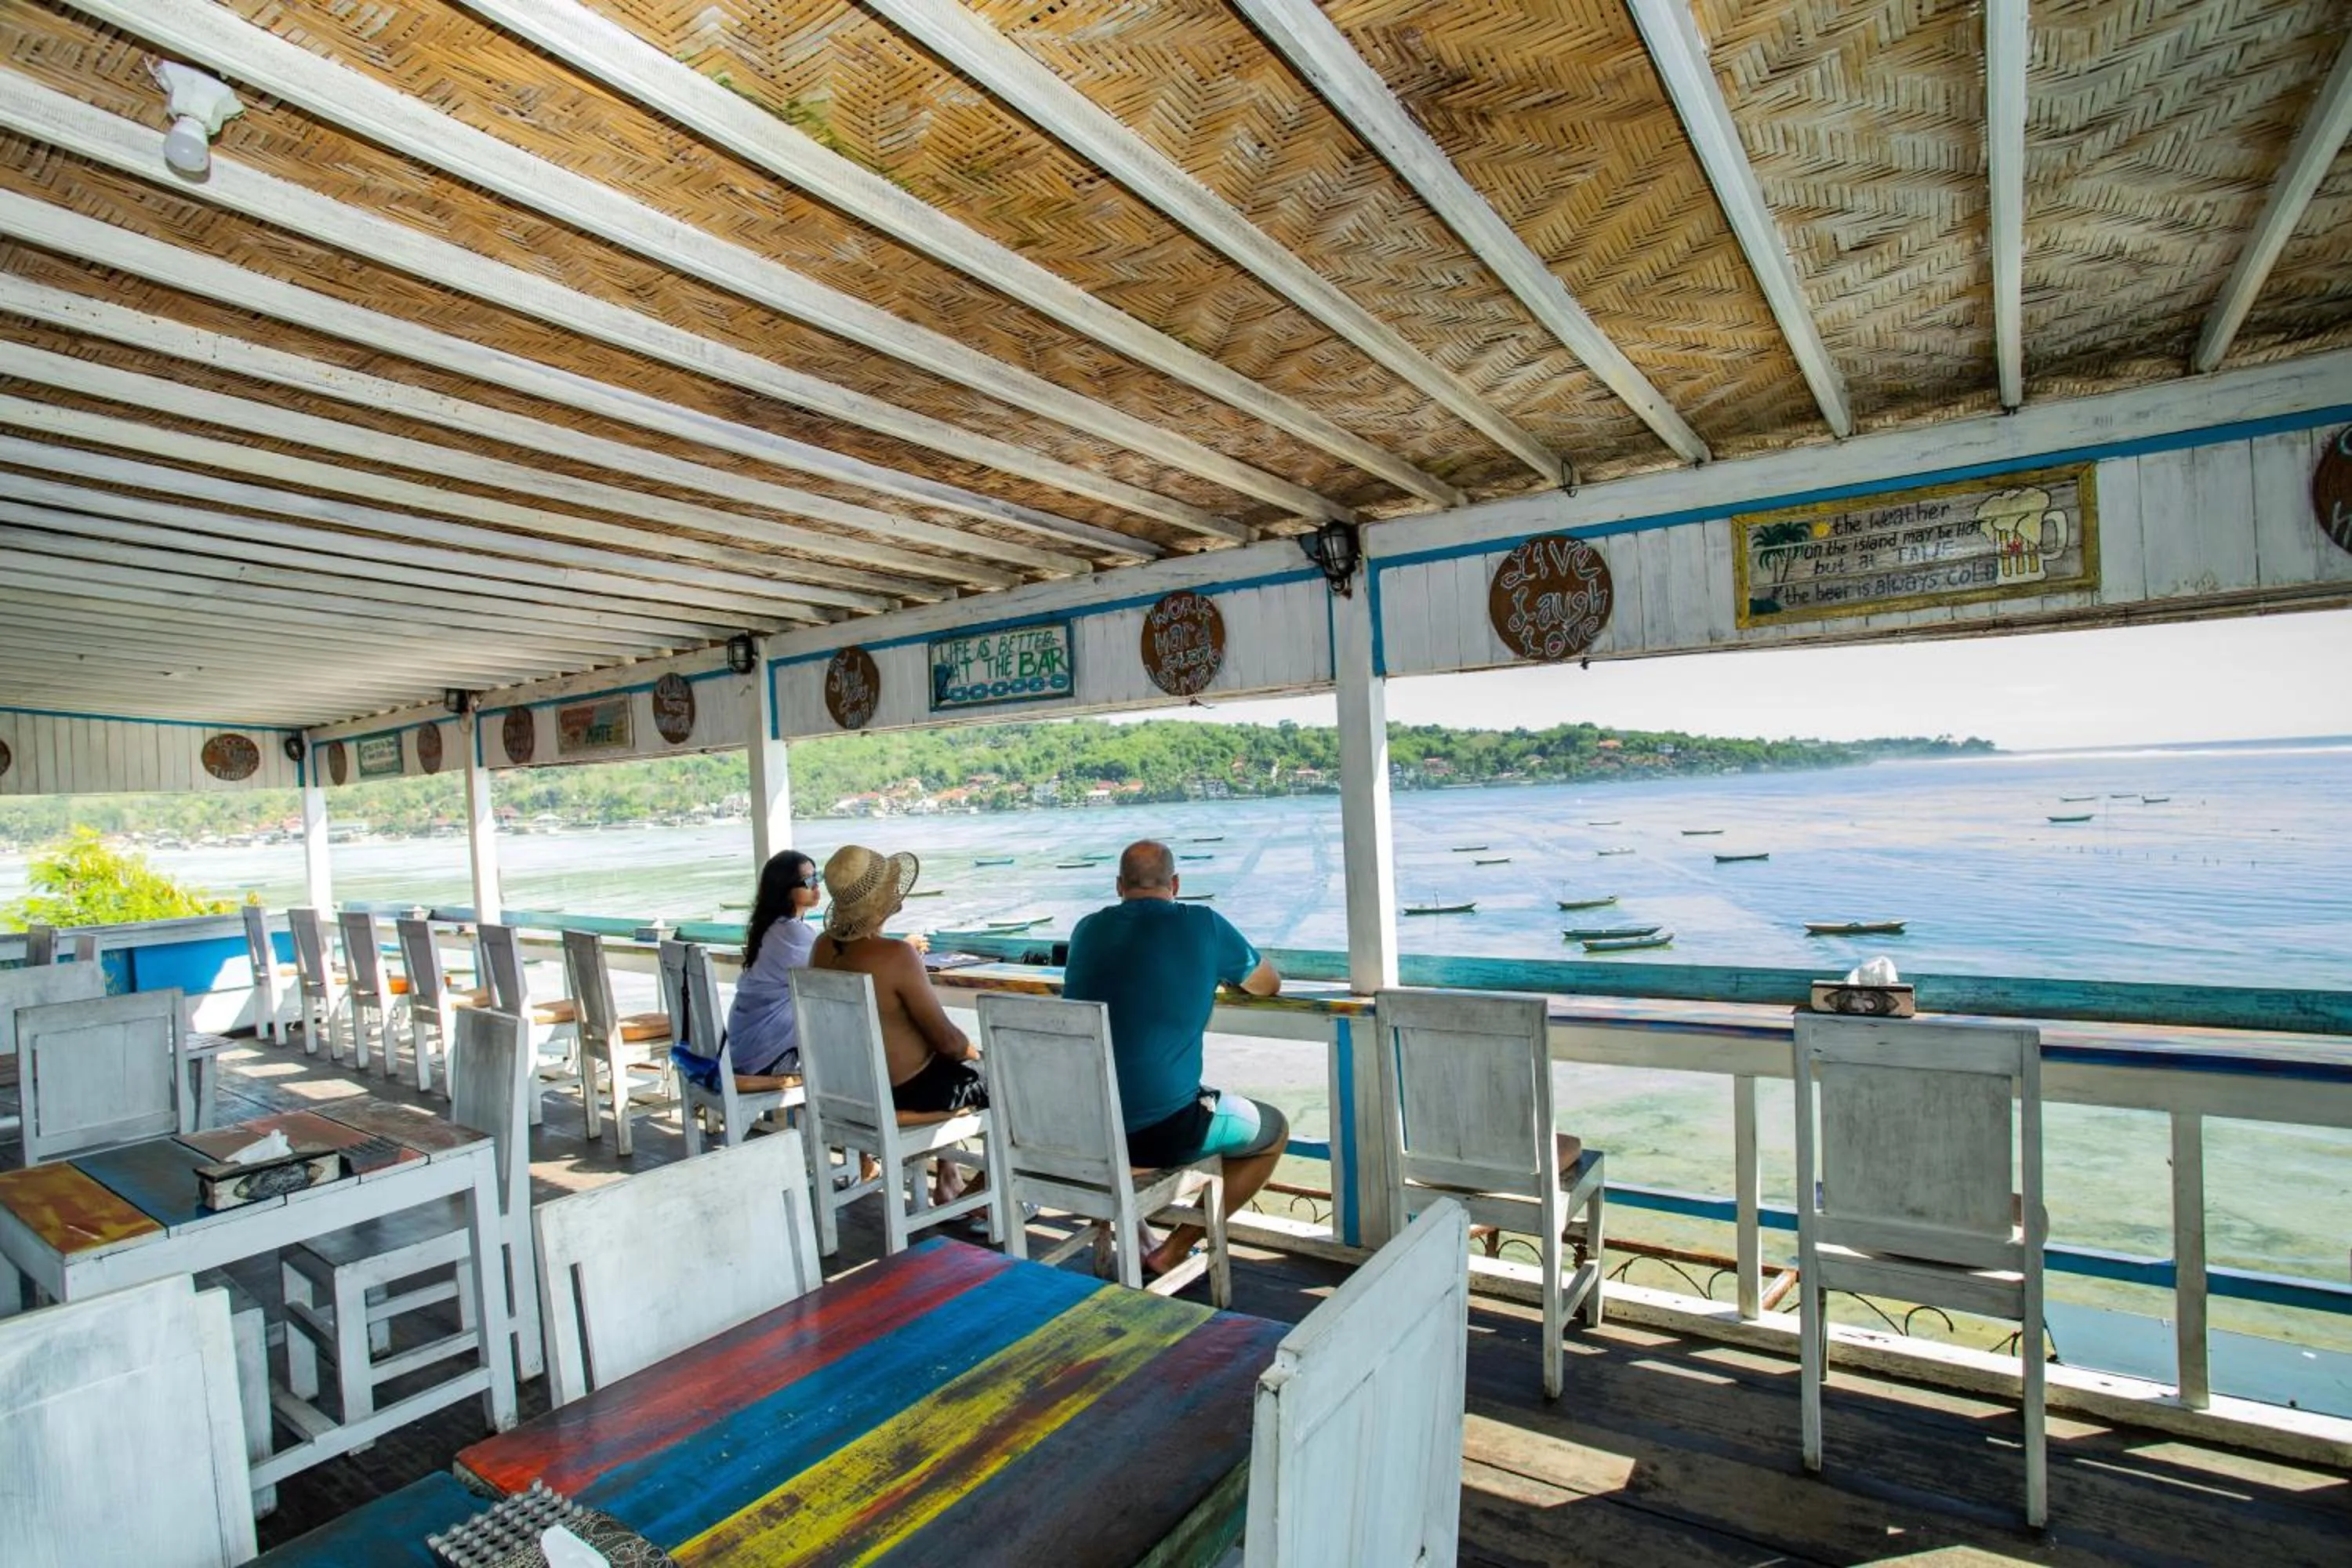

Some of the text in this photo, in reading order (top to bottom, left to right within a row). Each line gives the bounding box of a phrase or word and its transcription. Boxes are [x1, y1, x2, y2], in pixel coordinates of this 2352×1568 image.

[1853, 528, 1901, 552] island
[1813, 557, 1846, 575] but
[1875, 569, 1940, 597] always
[982, 655, 1014, 679] THE
[1019, 647, 1069, 678] BAR
